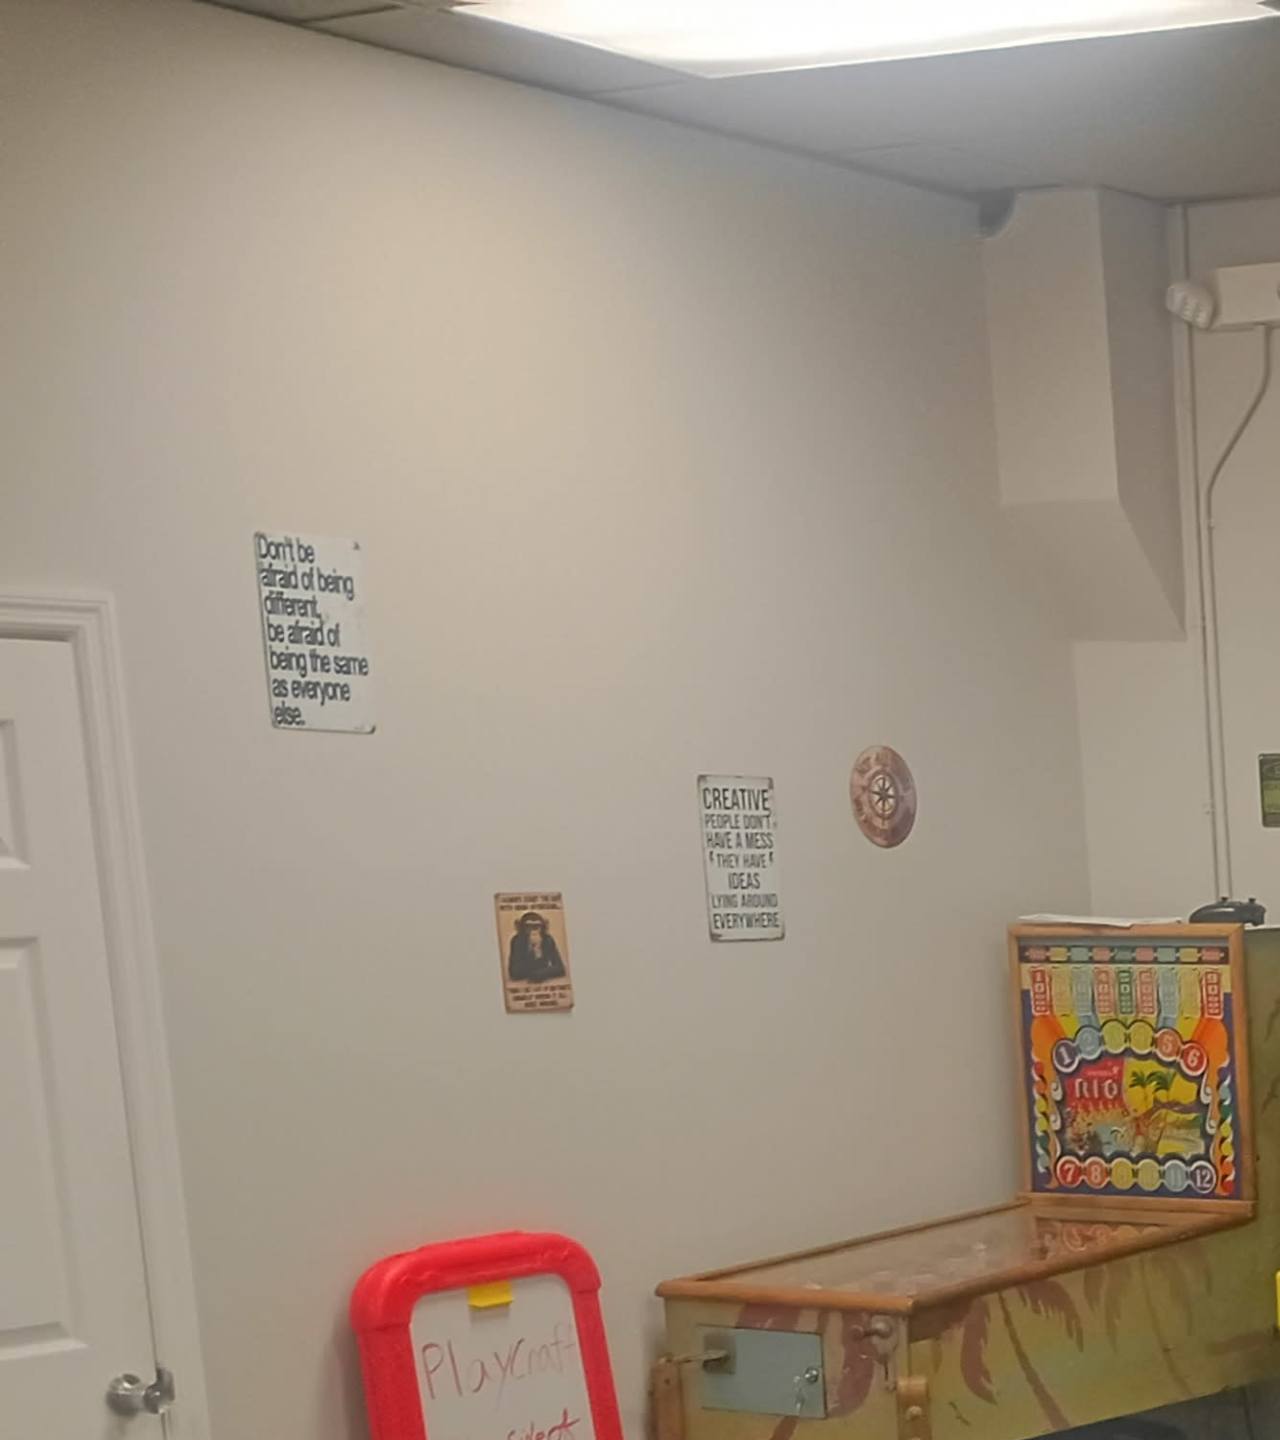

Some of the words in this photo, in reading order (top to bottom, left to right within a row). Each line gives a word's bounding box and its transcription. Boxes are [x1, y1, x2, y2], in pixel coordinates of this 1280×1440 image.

[258, 537, 295, 562] Don't
[298, 537, 315, 563] be
[260, 563, 298, 589] afraid
[301, 567, 314, 590] of
[317, 569, 354, 601] being
[267, 616, 284, 642] be
[288, 619, 324, 646] afraid
[327, 623, 340, 646] of
[270, 645, 307, 678] being
[310, 650, 330, 673] the
[334, 656, 368, 676] same
[272, 678, 288, 698] as
[291, 679, 351, 706] everyone
[274, 701, 305, 725] else.
[702, 787, 771, 811] CREATIVE
[704, 814, 740, 829] PEOPLE
[706, 832, 732, 848] HAVE
[735, 832, 743, 849] A
[746, 832, 774, 849] MESS
[717, 853, 740, 868] THEY
[743, 854, 767, 869] HAVE
[727, 872, 761, 889] IDEAS
[711, 894, 738, 908] LYING
[741, 893, 778, 908] AROUND
[713, 912, 780, 929] EVERYWHERE
[1195, 1168, 1212, 1188] 12
